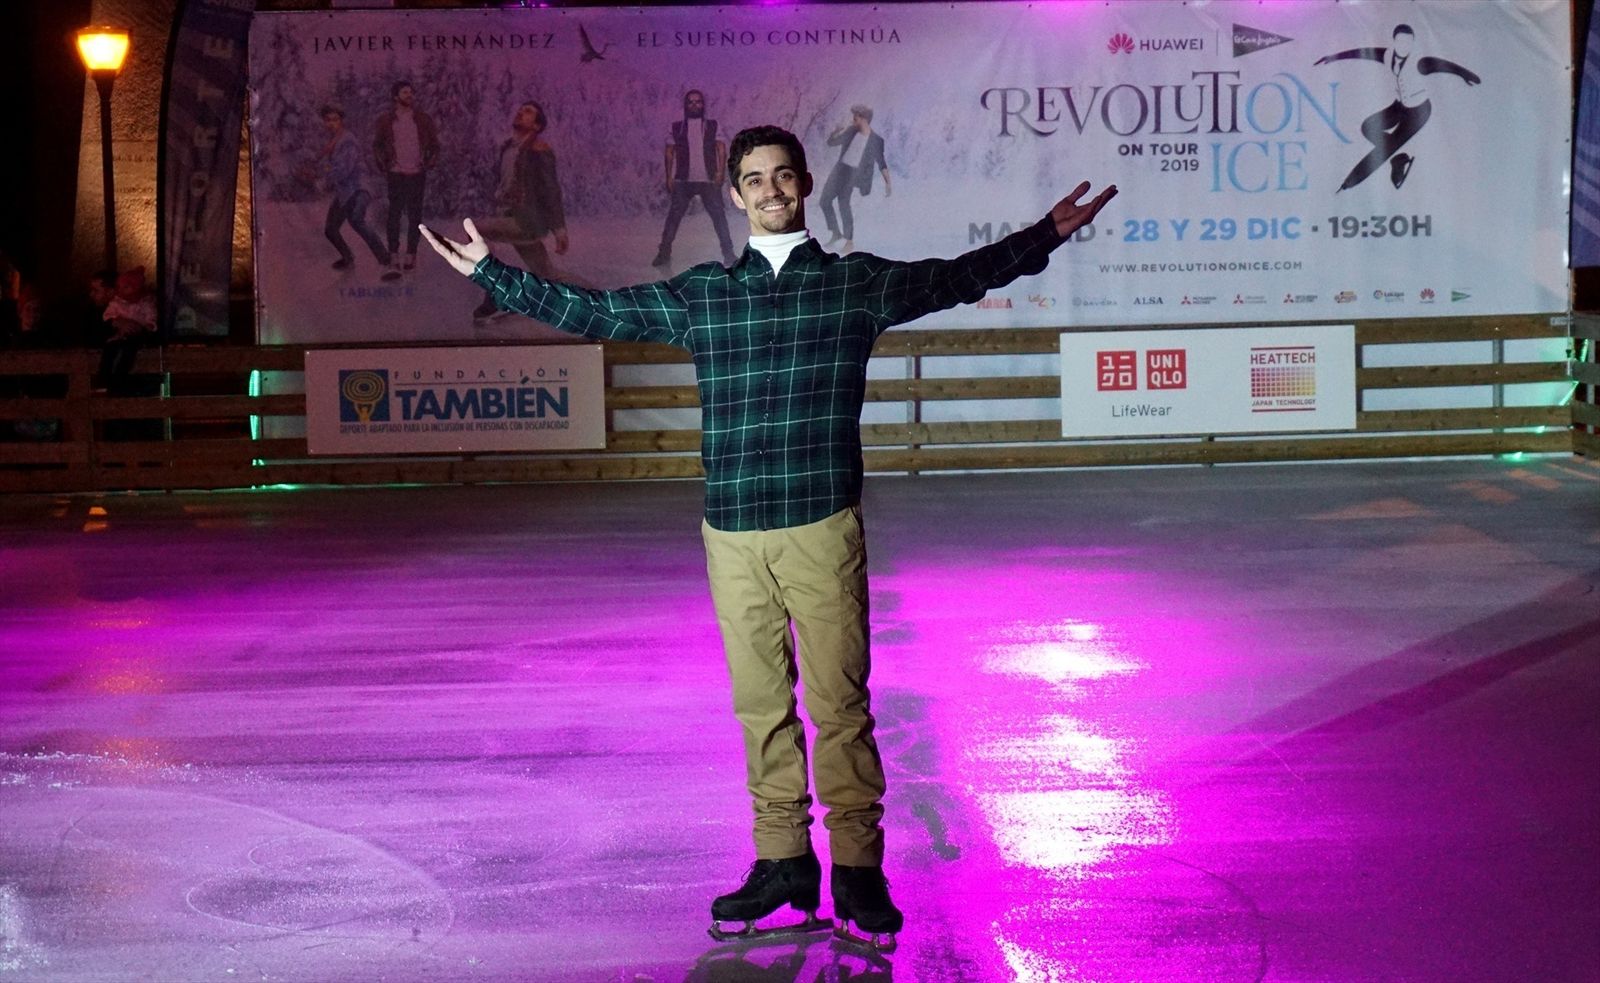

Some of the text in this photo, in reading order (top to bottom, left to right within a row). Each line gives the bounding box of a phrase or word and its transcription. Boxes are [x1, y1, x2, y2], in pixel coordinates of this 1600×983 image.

[314, 31, 556, 54] JAVIER FERNÁNDEZ
[637, 25, 902, 48] EL SUEÑO CONTINÚA
[1139, 38, 1204, 51] HUAWEI
[980, 70, 1353, 143] REVOLUTION
[1118, 142, 1199, 156] ON TOUR
[1160, 159, 1200, 172] 2019
[1209, 140, 1309, 194] ICE
[1123, 219, 1160, 243] 28
[1169, 218, 1190, 242] Y
[1199, 217, 1238, 242] 29
[1247, 216, 1302, 241] DIC
[1328, 214, 1433, 239] 19:30H
[1100, 260, 1303, 274] WWW.REVOLUTIONONICE.COM
[1132, 296, 1164, 305] ALSA
[1150, 353, 1179, 369] UNI
[1250, 352, 1316, 365] HEATTECH
[394, 367, 569, 381] FUNDACIÓN
[1151, 370, 1183, 388] QLO
[394, 376, 569, 421] TAMBIÉN
[1251, 398, 1317, 407] JAPAN TECHNOLOGY
[1111, 404, 1173, 418] LifeWear
